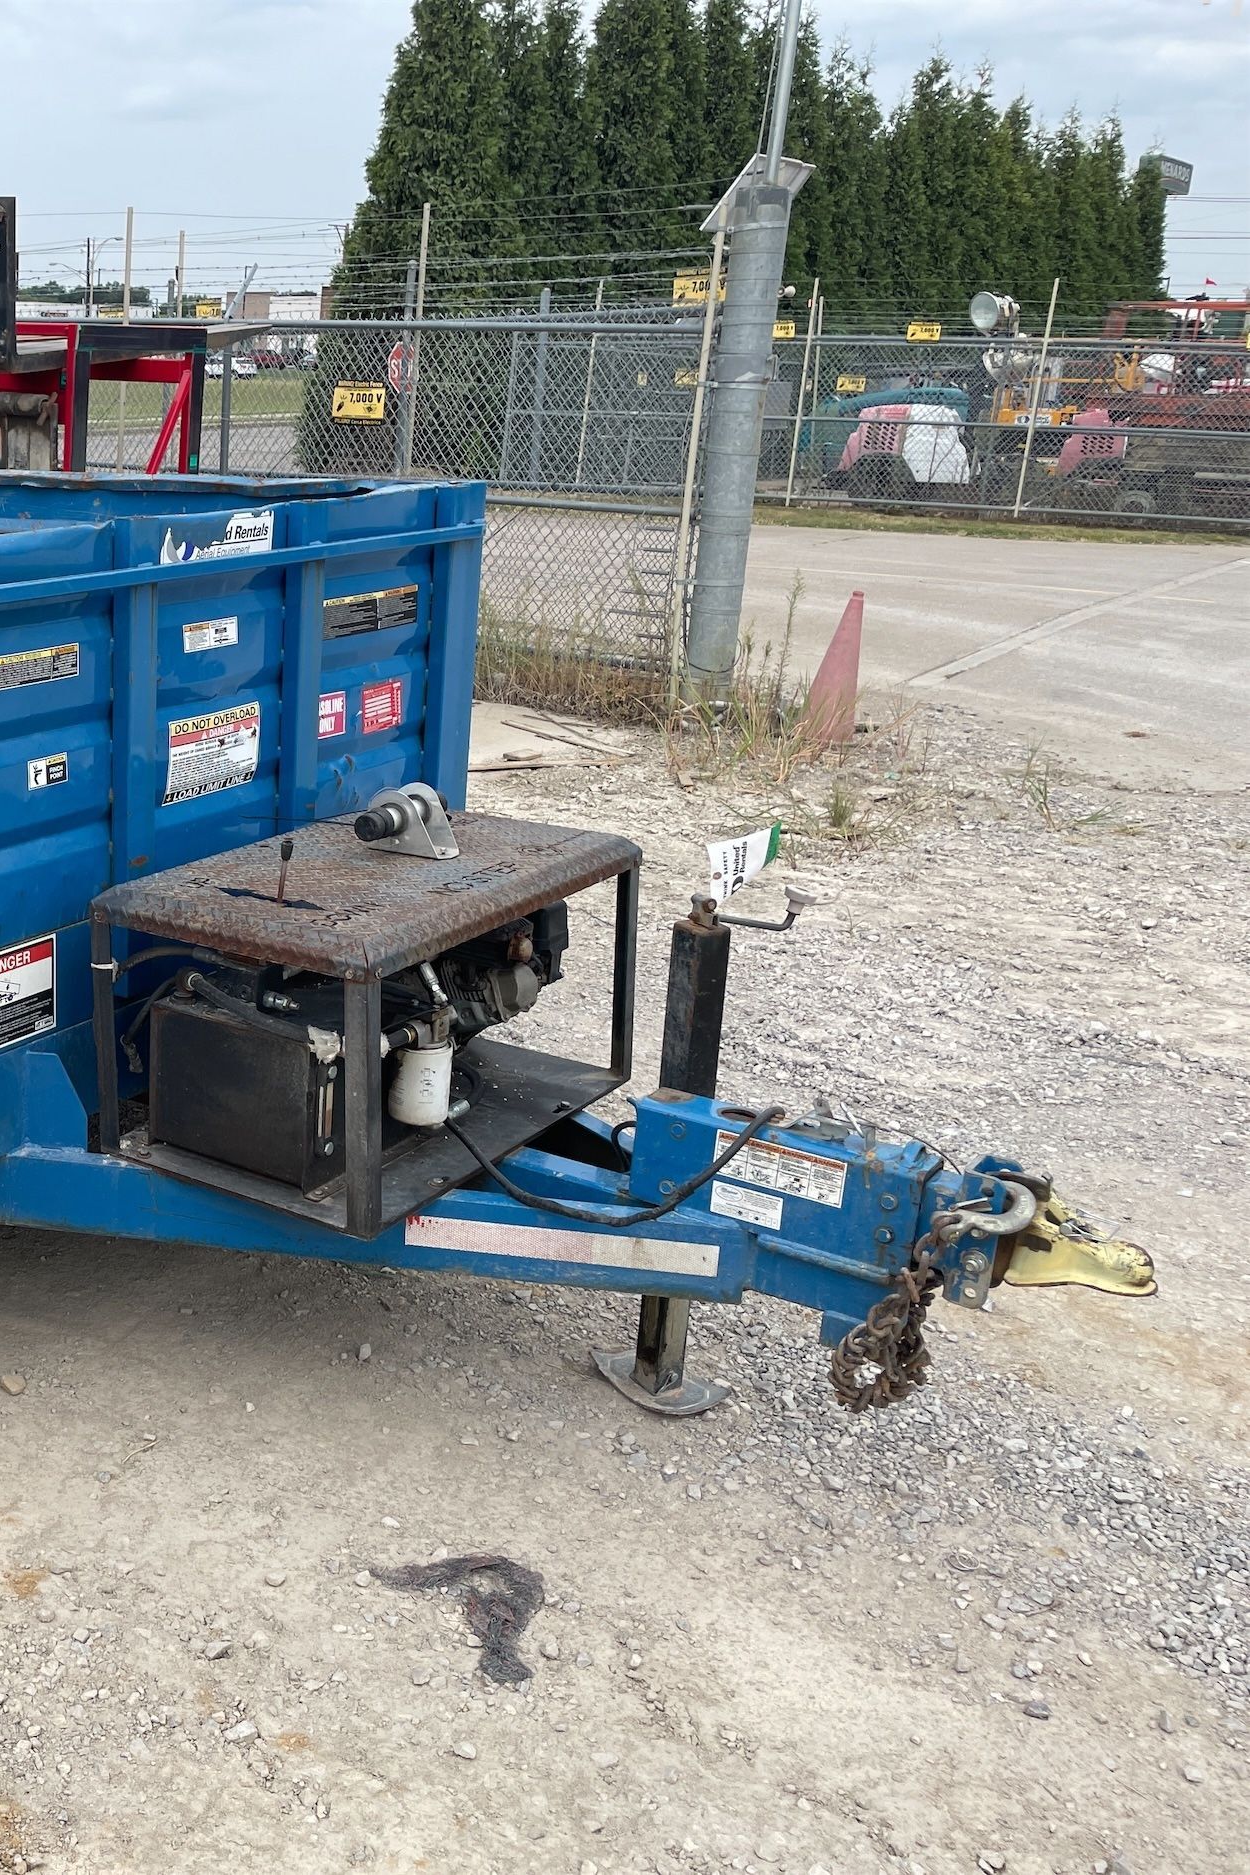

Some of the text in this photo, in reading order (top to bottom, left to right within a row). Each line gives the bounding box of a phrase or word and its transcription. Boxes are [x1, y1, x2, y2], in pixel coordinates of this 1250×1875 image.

[350, 393, 383, 404] 7,000 V
[234, 523, 269, 540] Rentals
[175, 707, 256, 735] DO NOT OVERLOAD
[209, 725, 235, 737] DANGER
[319, 716, 336, 733] ONLY
[173, 774, 246, 800] LOAD LIMIT LINE
[732, 845, 740, 876] United
[739, 841, 748, 873] Rentals
